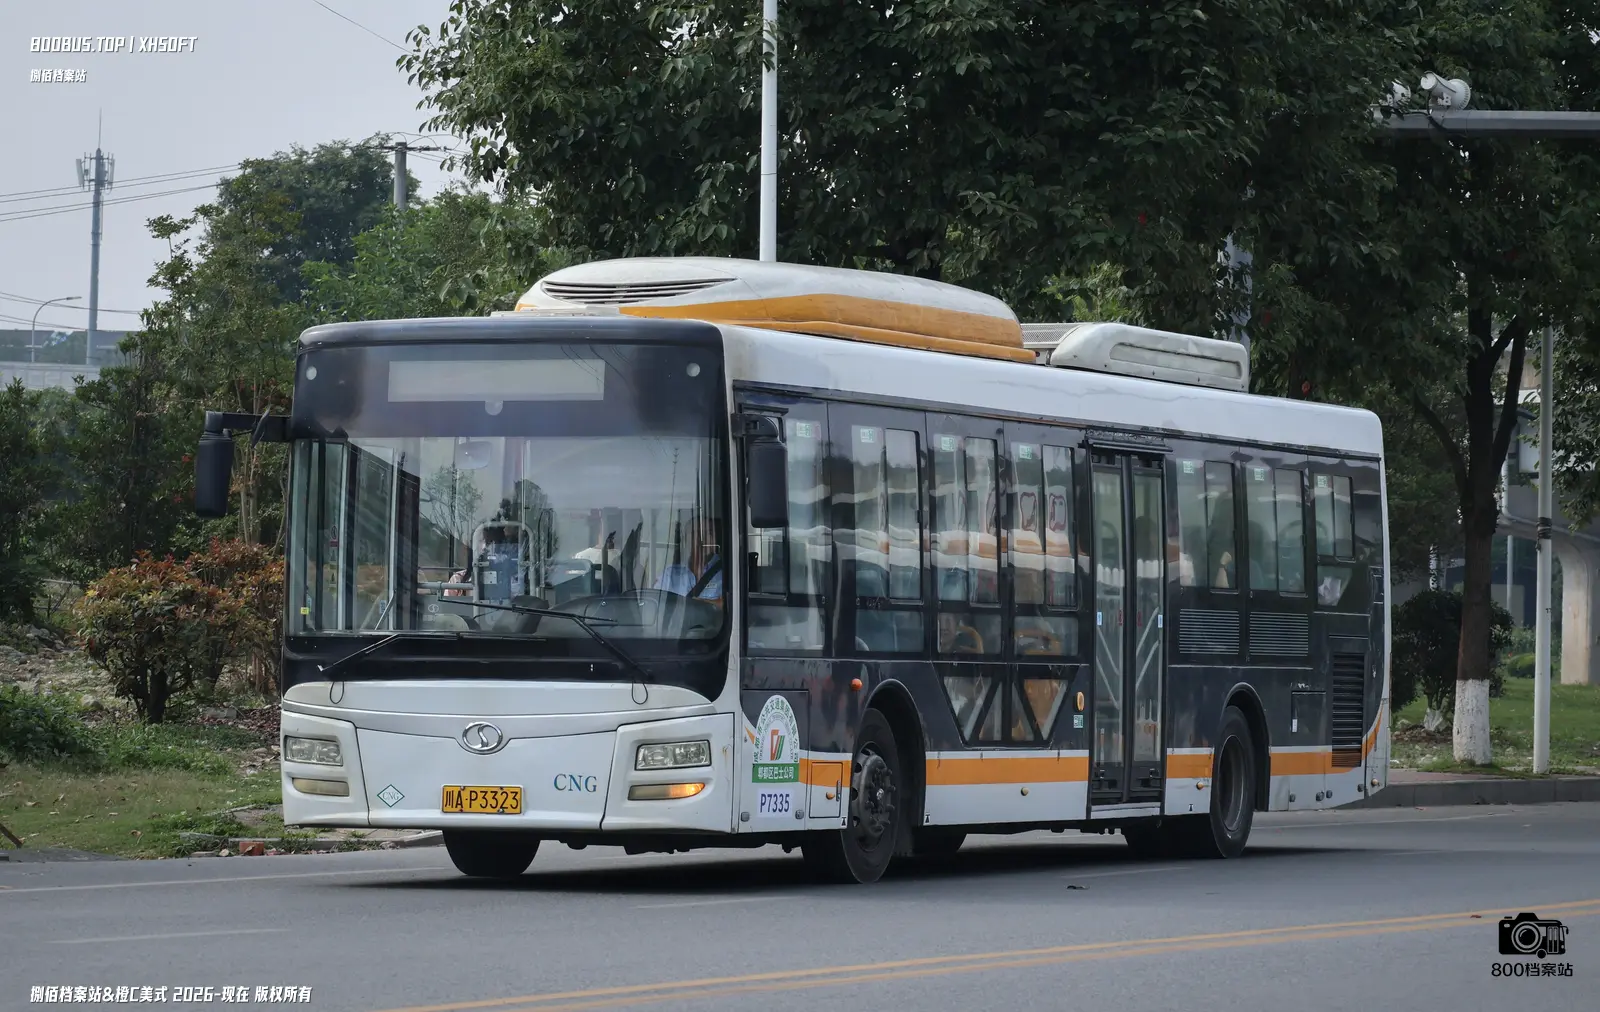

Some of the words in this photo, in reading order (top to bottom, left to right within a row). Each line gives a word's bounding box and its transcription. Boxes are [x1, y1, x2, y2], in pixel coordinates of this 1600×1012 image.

[757, 766, 795, 780] 郫都区巴士公司
[553, 774, 598, 793] CNG
[382, 791, 400, 801] CNG
[760, 793, 790, 813] P7335
